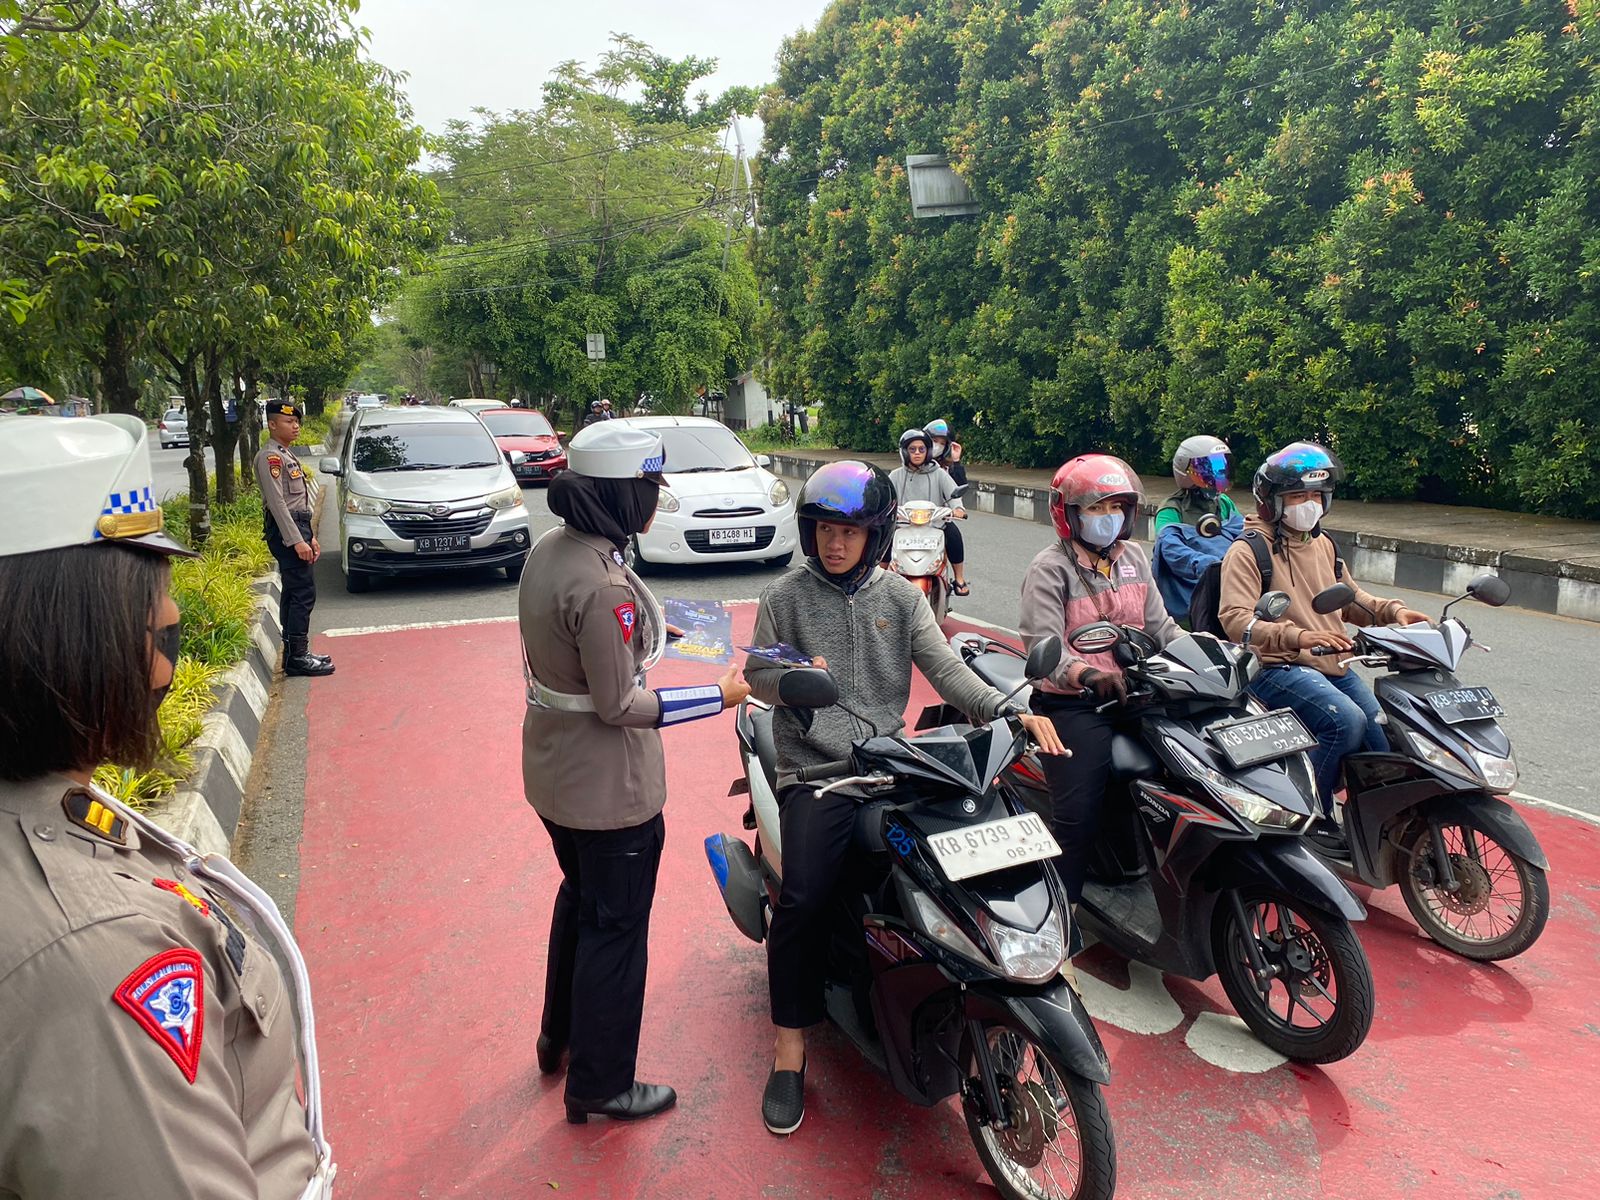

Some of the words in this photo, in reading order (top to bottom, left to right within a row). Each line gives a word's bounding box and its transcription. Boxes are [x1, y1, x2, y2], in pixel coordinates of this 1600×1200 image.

[420, 538, 430, 549] KB
[434, 537, 453, 548] 1237
[455, 535, 466, 546] WF
[711, 530, 721, 540] KB
[722, 530, 741, 539] 1488
[743, 529, 753, 538] HI
[1430, 693, 1451, 709] KB
[1449, 689, 1478, 704] 3588
[1219, 730, 1243, 748] KB
[1239, 721, 1277, 741] 5264
[1273, 717, 1294, 734] MF
[1140, 790, 1171, 818] HONDA
[934, 837, 962, 857] KB
[964, 825, 1010, 849] 6739
[1018, 816, 1043, 836] DV
